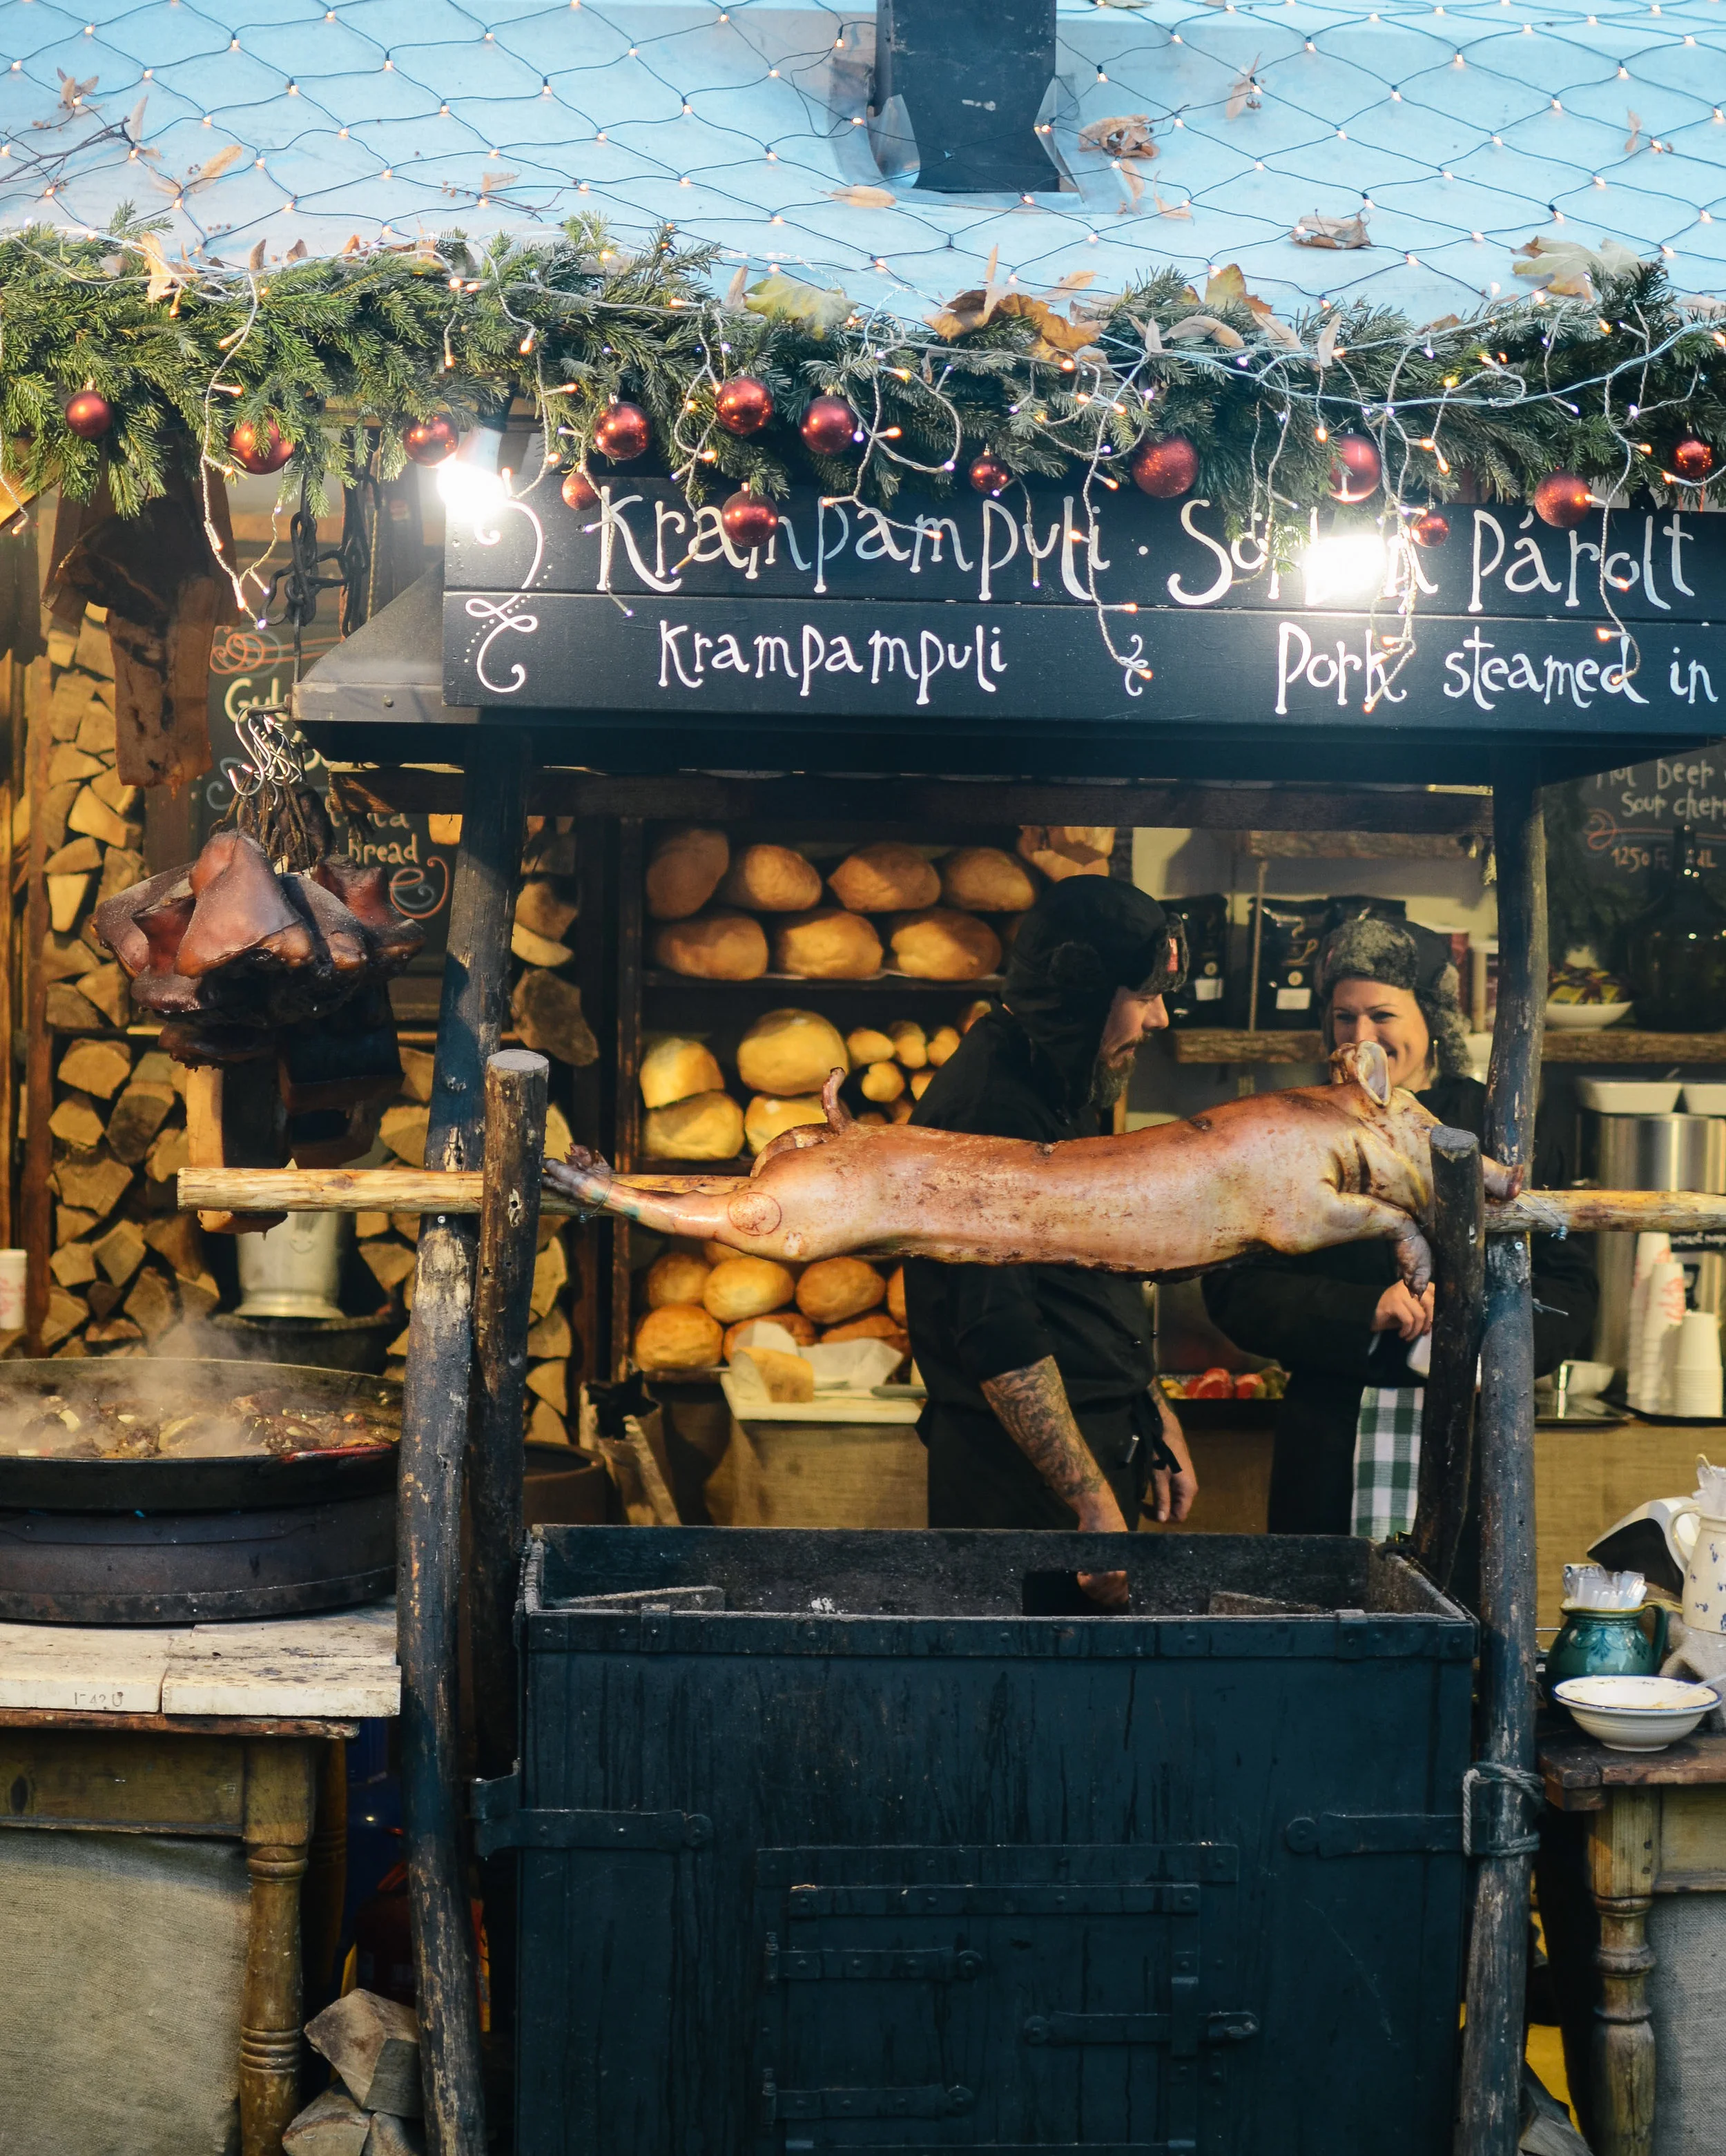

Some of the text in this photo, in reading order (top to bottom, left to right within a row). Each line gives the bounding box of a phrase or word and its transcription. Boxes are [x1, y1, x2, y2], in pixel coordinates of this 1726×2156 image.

[659, 620, 1718, 715] Krampampuli Pork steamed in
